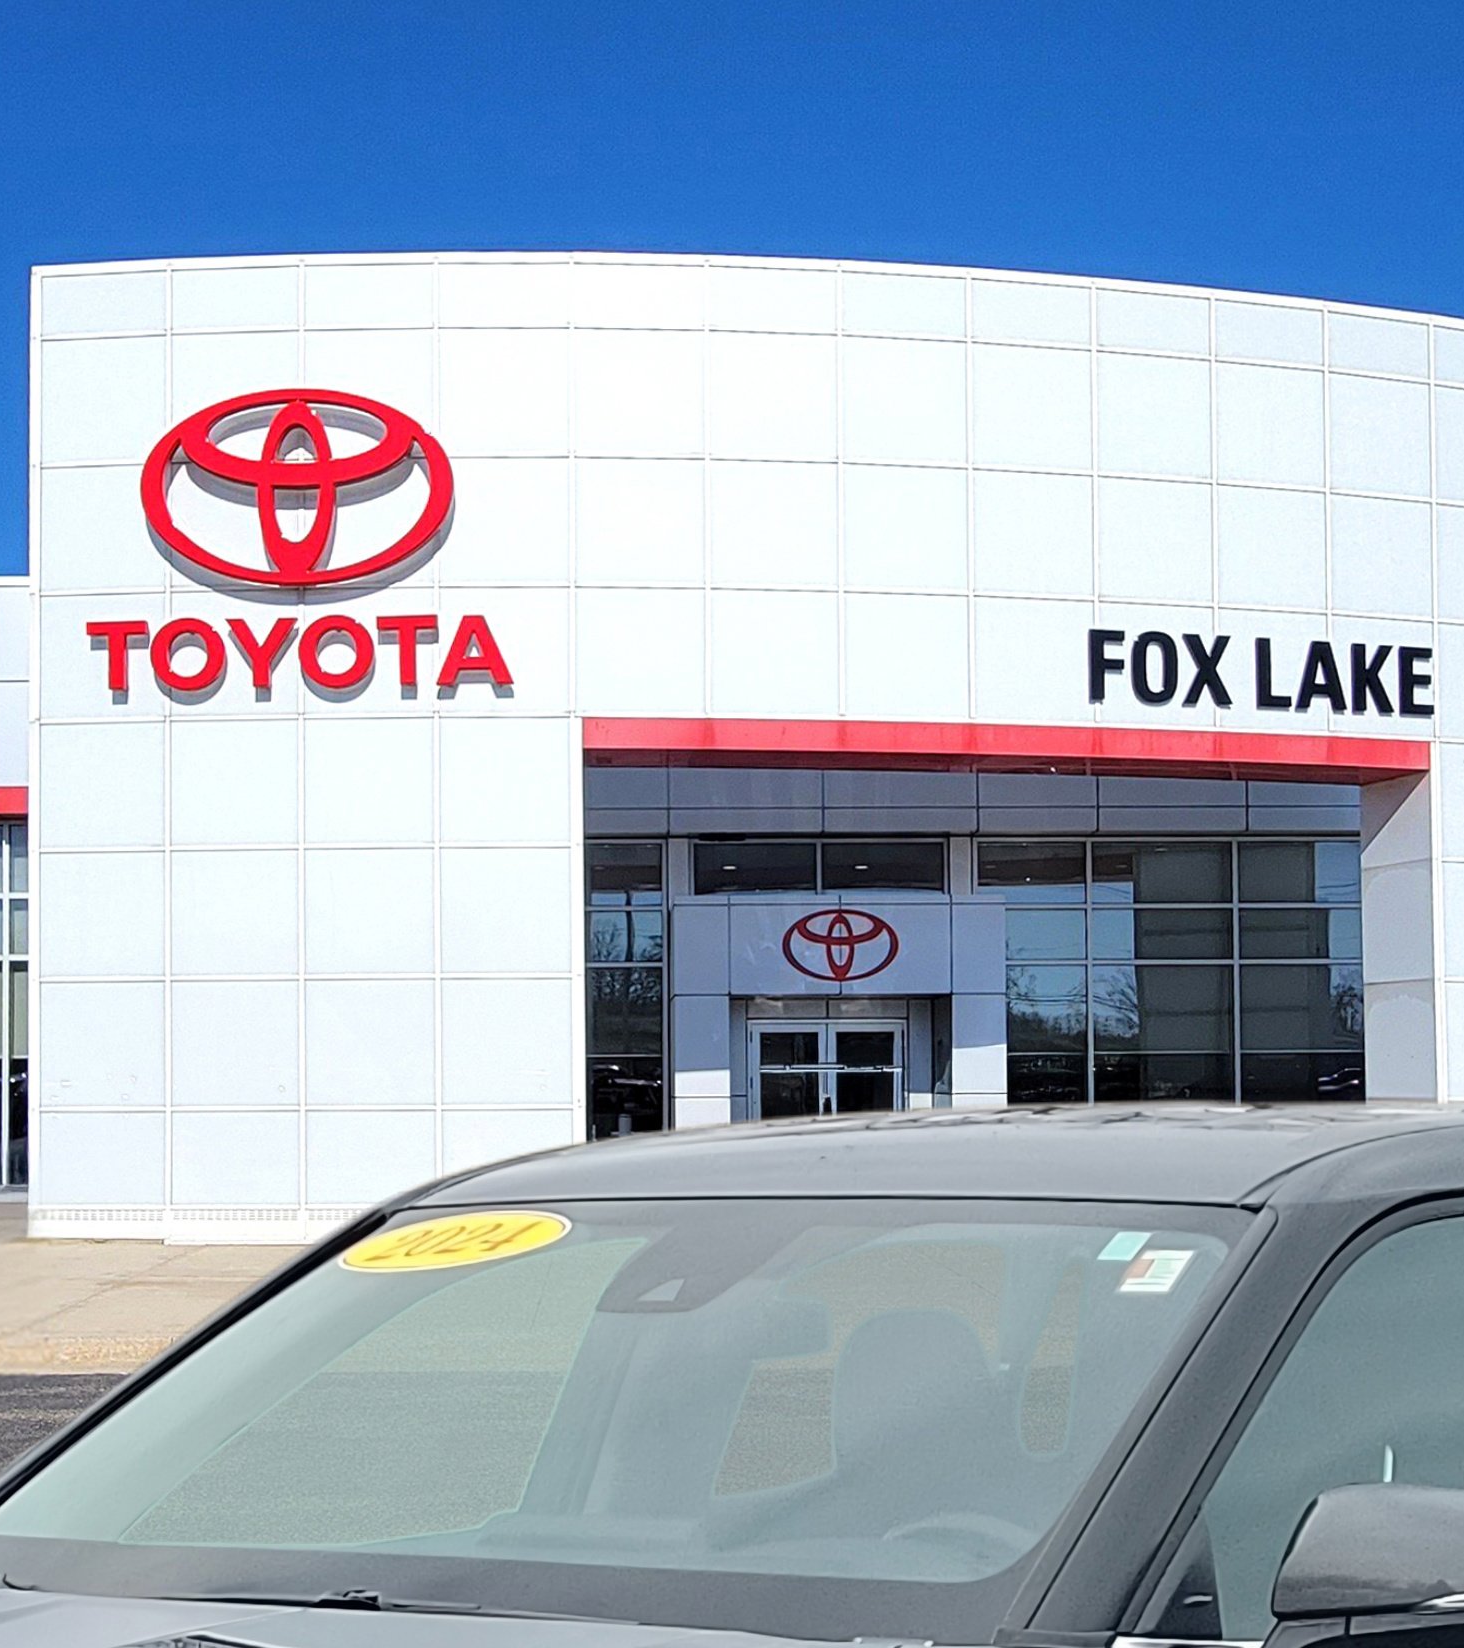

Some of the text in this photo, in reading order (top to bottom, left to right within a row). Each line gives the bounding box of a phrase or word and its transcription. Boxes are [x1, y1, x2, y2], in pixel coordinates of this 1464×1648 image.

[86, 614, 514, 700] TOYOTA
[1087, 628, 1436, 716] FOX LAKE
[363, 1220, 543, 1263] 2024
